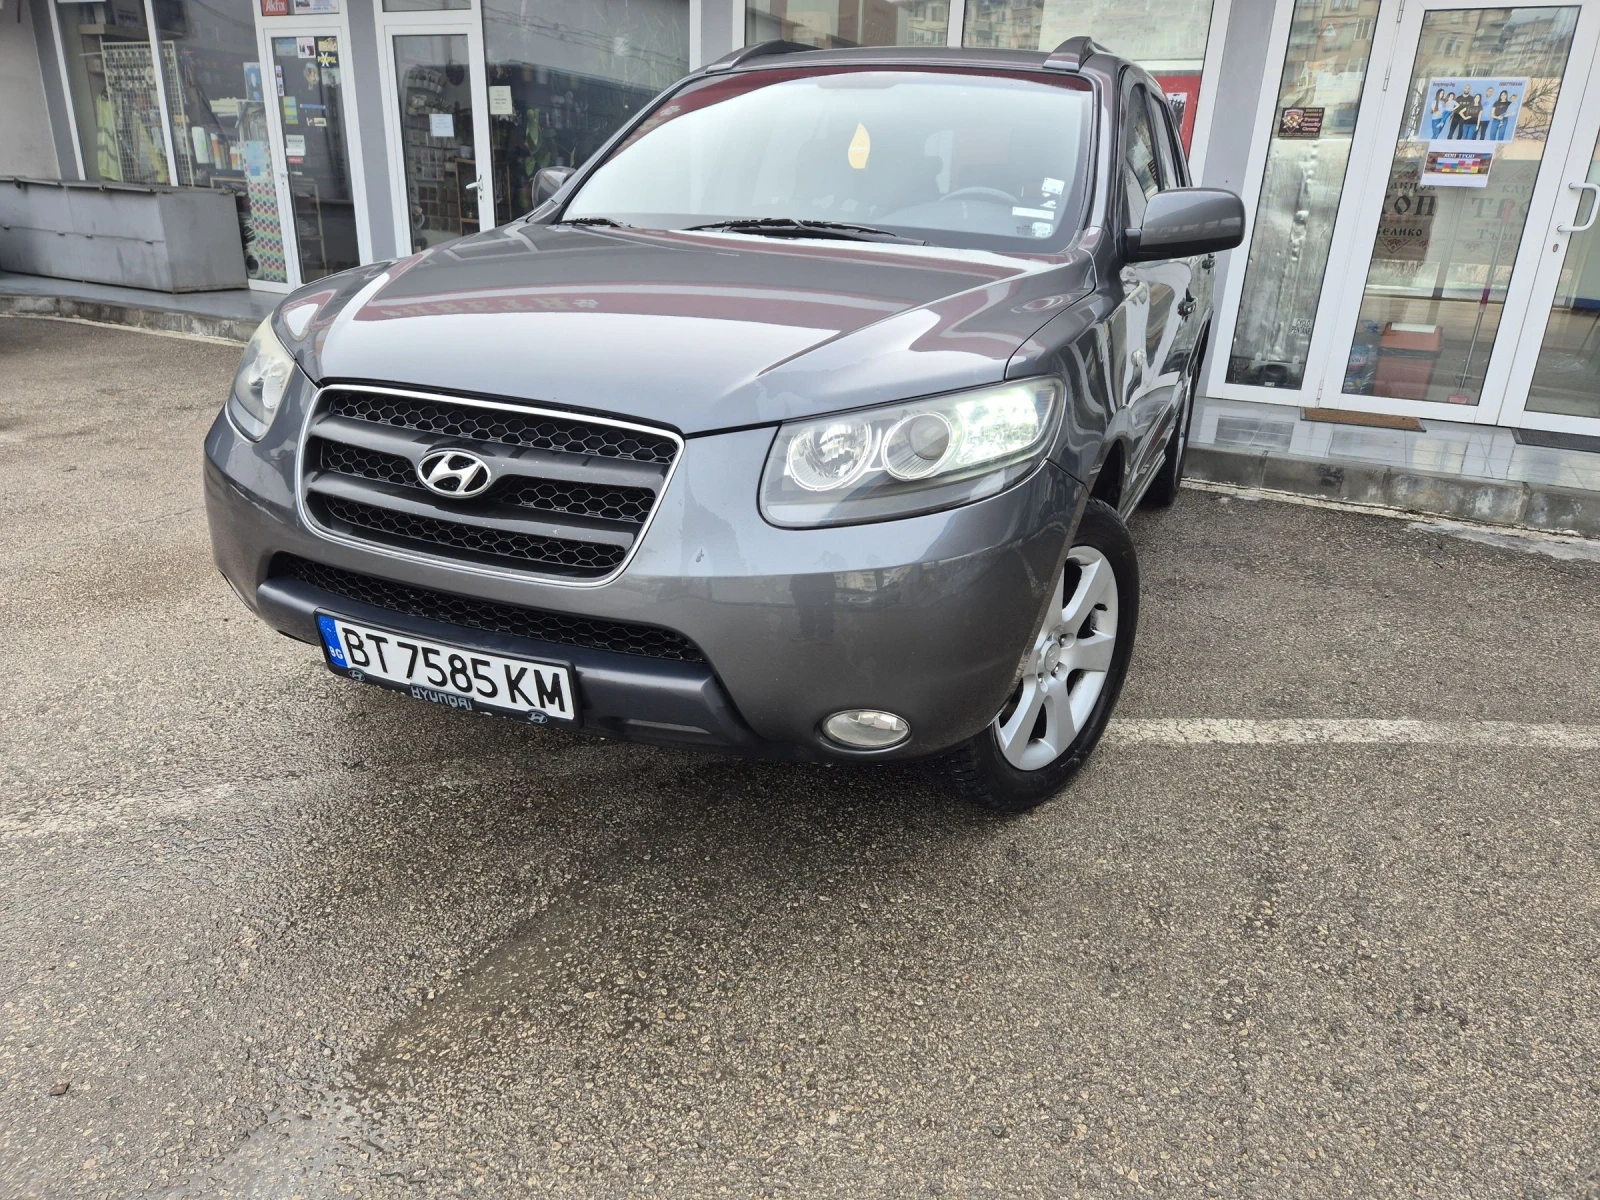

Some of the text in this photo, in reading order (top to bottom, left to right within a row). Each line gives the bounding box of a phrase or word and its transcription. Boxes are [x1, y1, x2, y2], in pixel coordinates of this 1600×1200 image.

[329, 645, 344, 660] BG
[341, 627, 566, 713] BT 7585 KM
[410, 686, 473, 711] HYUNDAI
